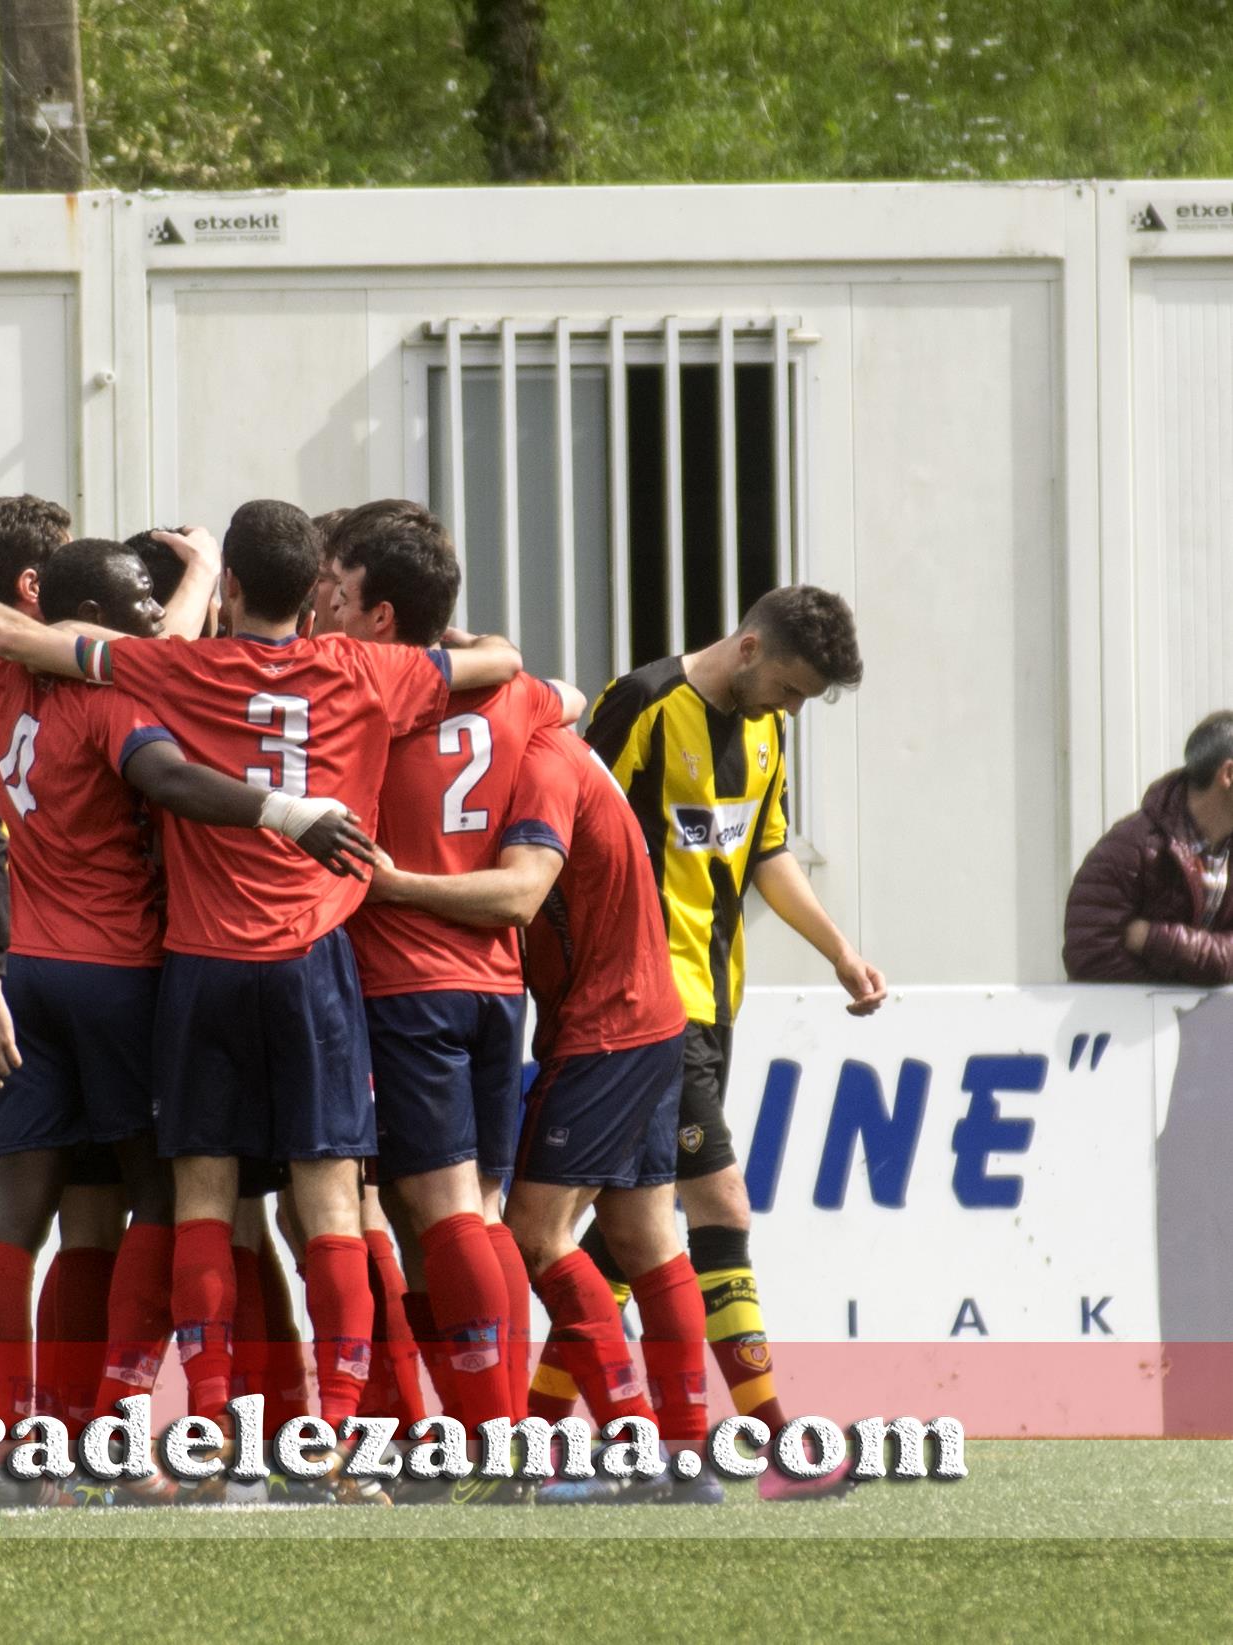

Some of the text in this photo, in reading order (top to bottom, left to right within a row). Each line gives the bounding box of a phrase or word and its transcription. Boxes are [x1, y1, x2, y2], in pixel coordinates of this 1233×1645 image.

[193, 213, 280, 230] etxekit
[245, 691, 310, 799] 3
[437, 711, 493, 835] 2
[744, 1031, 1113, 1214] INE"
